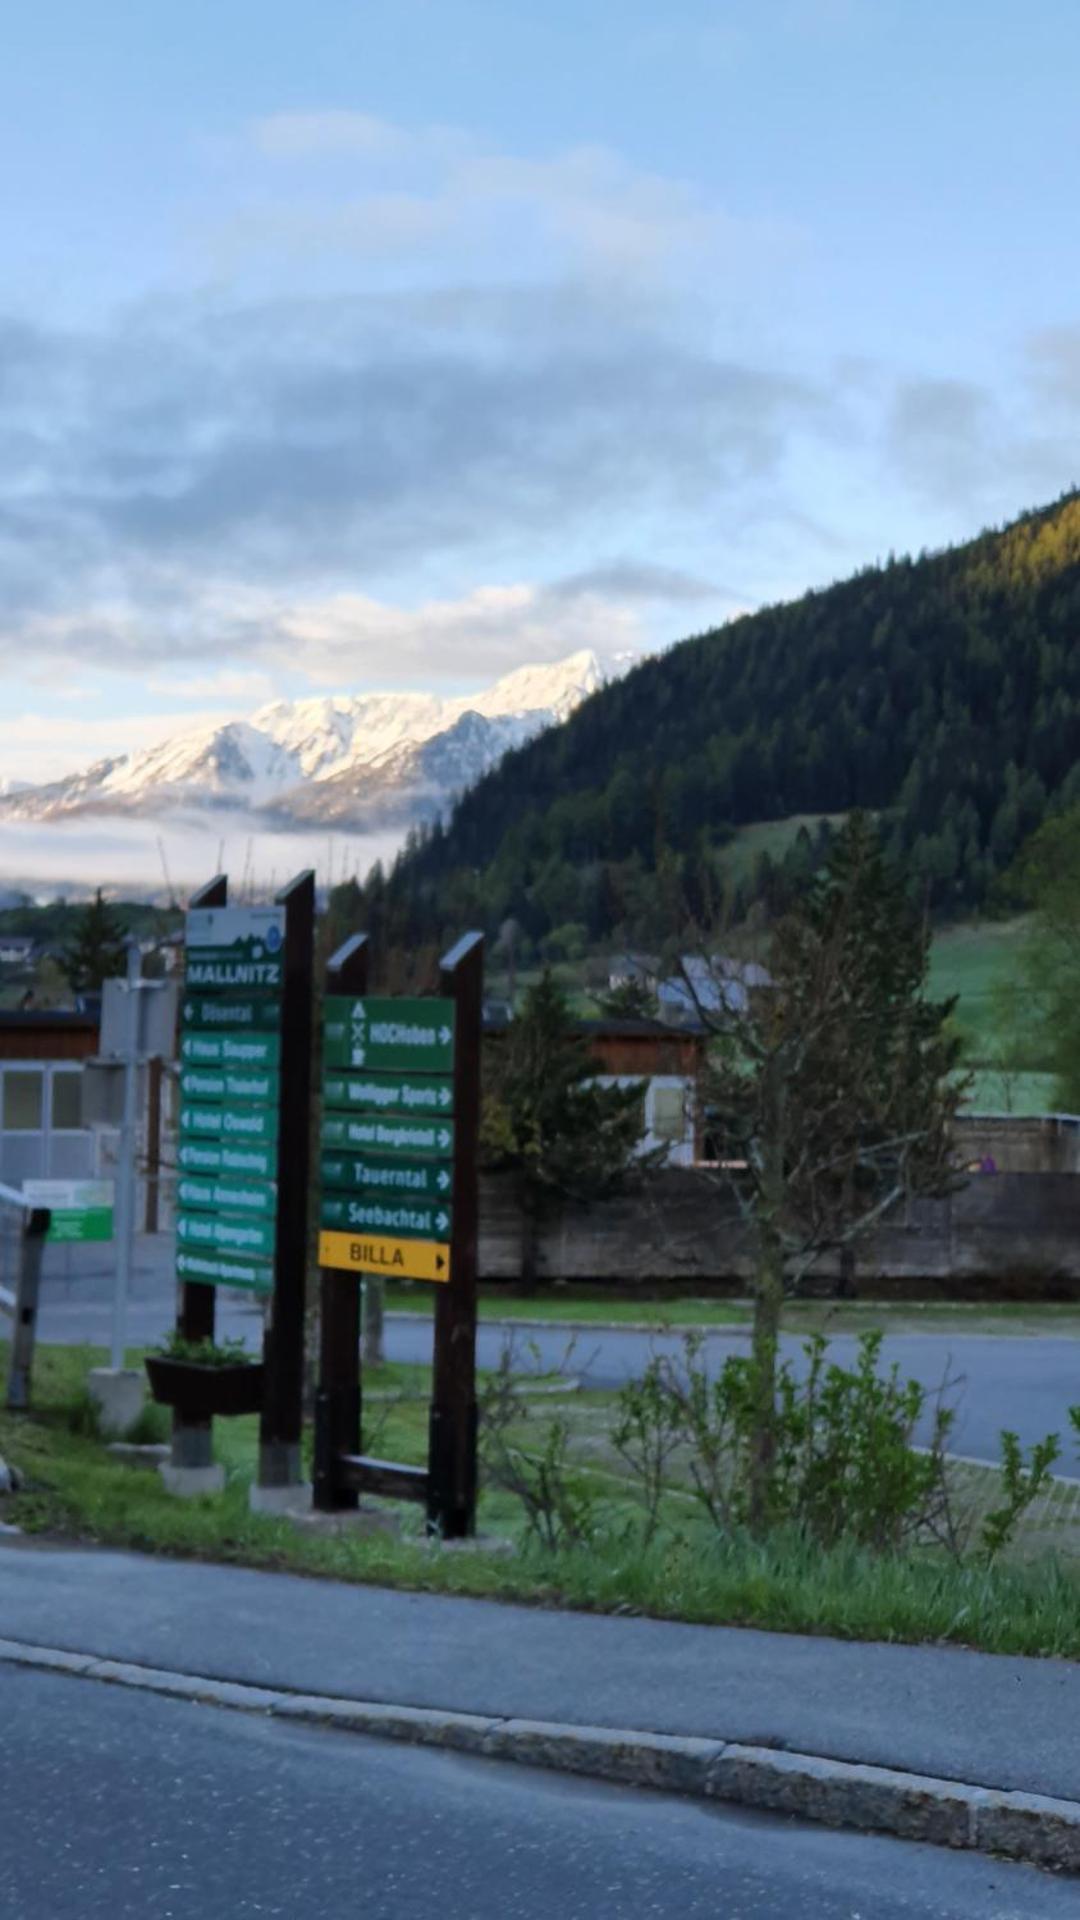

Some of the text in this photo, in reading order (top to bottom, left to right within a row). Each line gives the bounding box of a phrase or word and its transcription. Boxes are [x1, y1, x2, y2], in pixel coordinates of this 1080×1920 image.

[187, 963, 280, 985] MALLNITZ
[354, 1162, 427, 1189] Tauerntal
[348, 1202, 431, 1231] Seebachtal
[350, 1242, 404, 1267] BILLA
